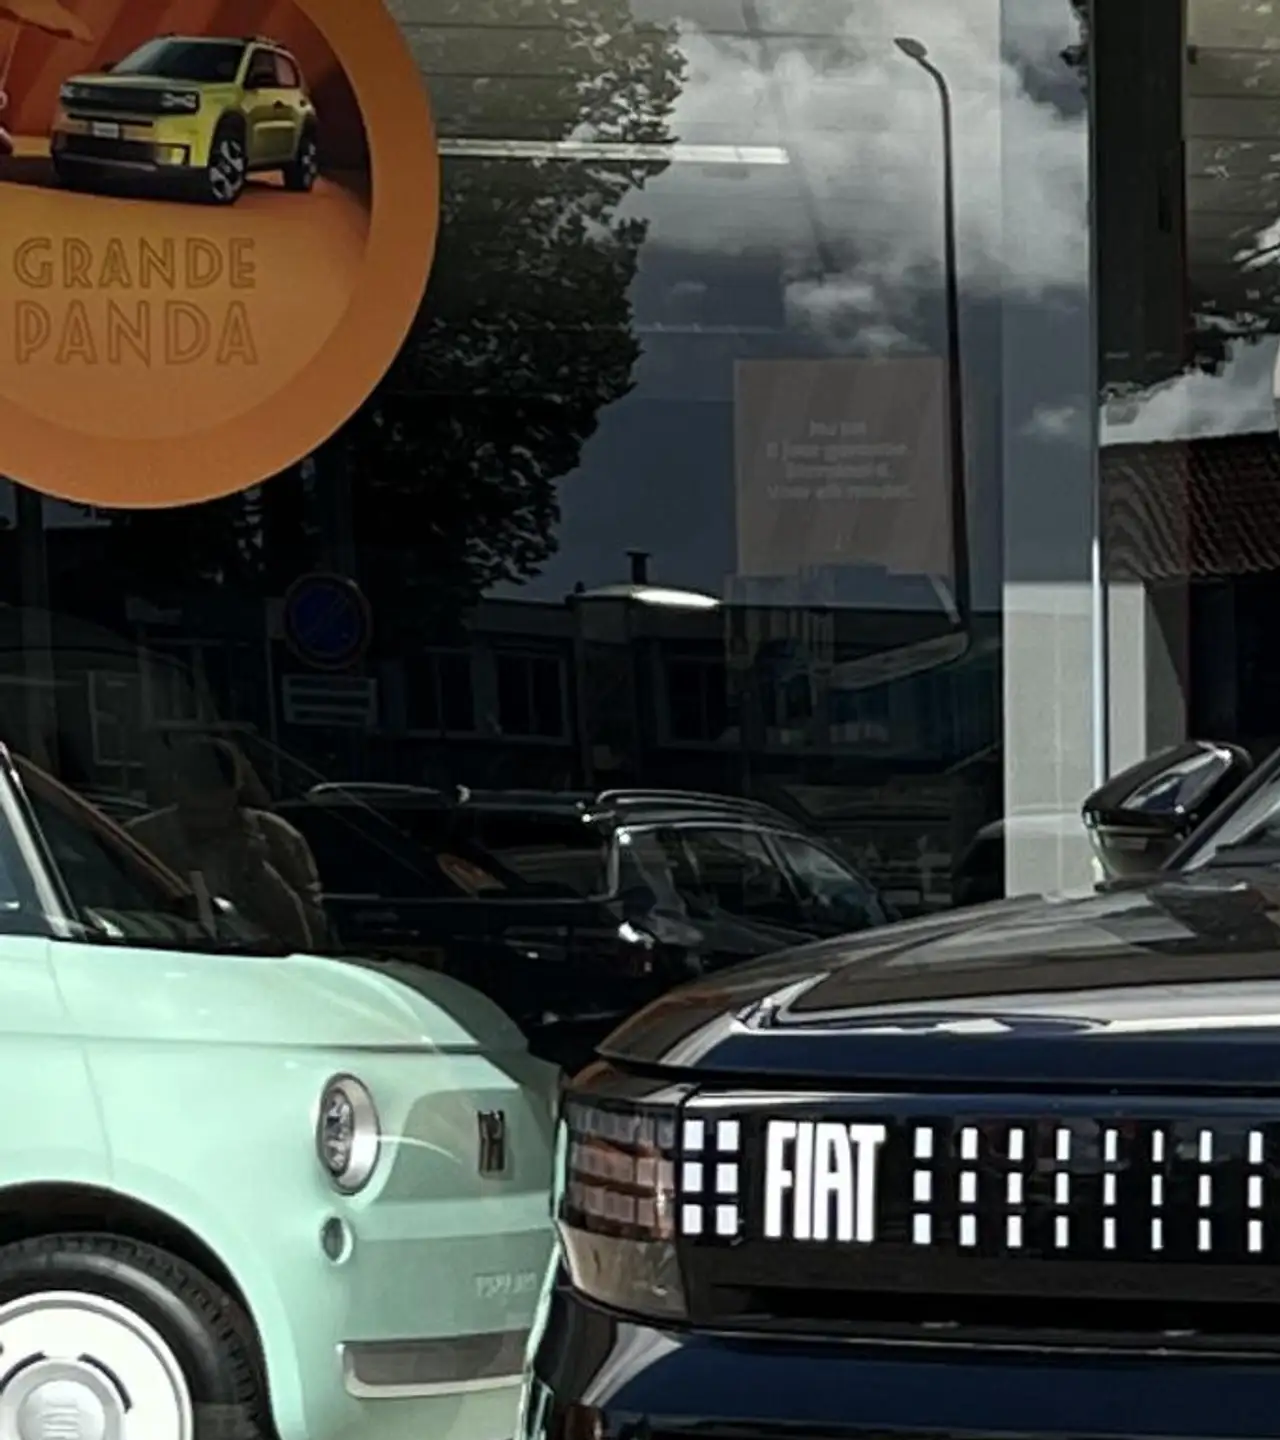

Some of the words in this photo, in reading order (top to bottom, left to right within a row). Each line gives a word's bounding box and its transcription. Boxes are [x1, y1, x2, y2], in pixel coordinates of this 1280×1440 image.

[13, 237, 257, 290] GRANDE
[13, 299, 259, 368] PANDA
[765, 1121, 886, 1242] FIAT
